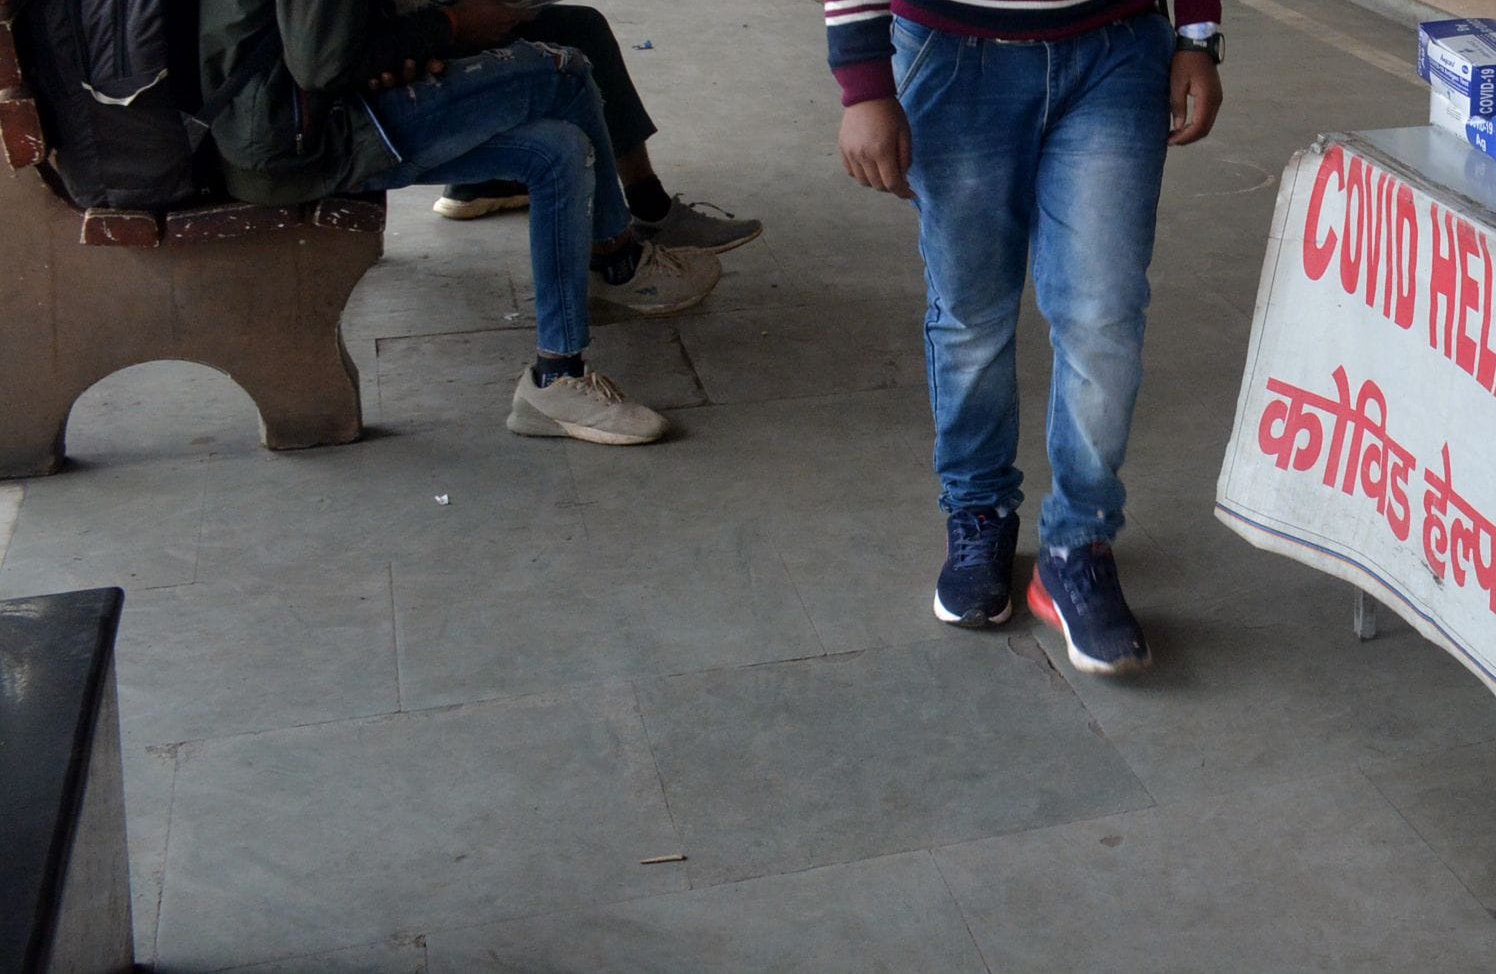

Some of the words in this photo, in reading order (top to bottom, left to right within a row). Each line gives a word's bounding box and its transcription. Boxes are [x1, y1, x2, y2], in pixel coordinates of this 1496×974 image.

[1475, 133, 1486, 152] Ag
[1479, 68, 1495, 114] COVID-19
[1303, 145, 1418, 330] COVID
[1257, 364, 1416, 542] कोविड
